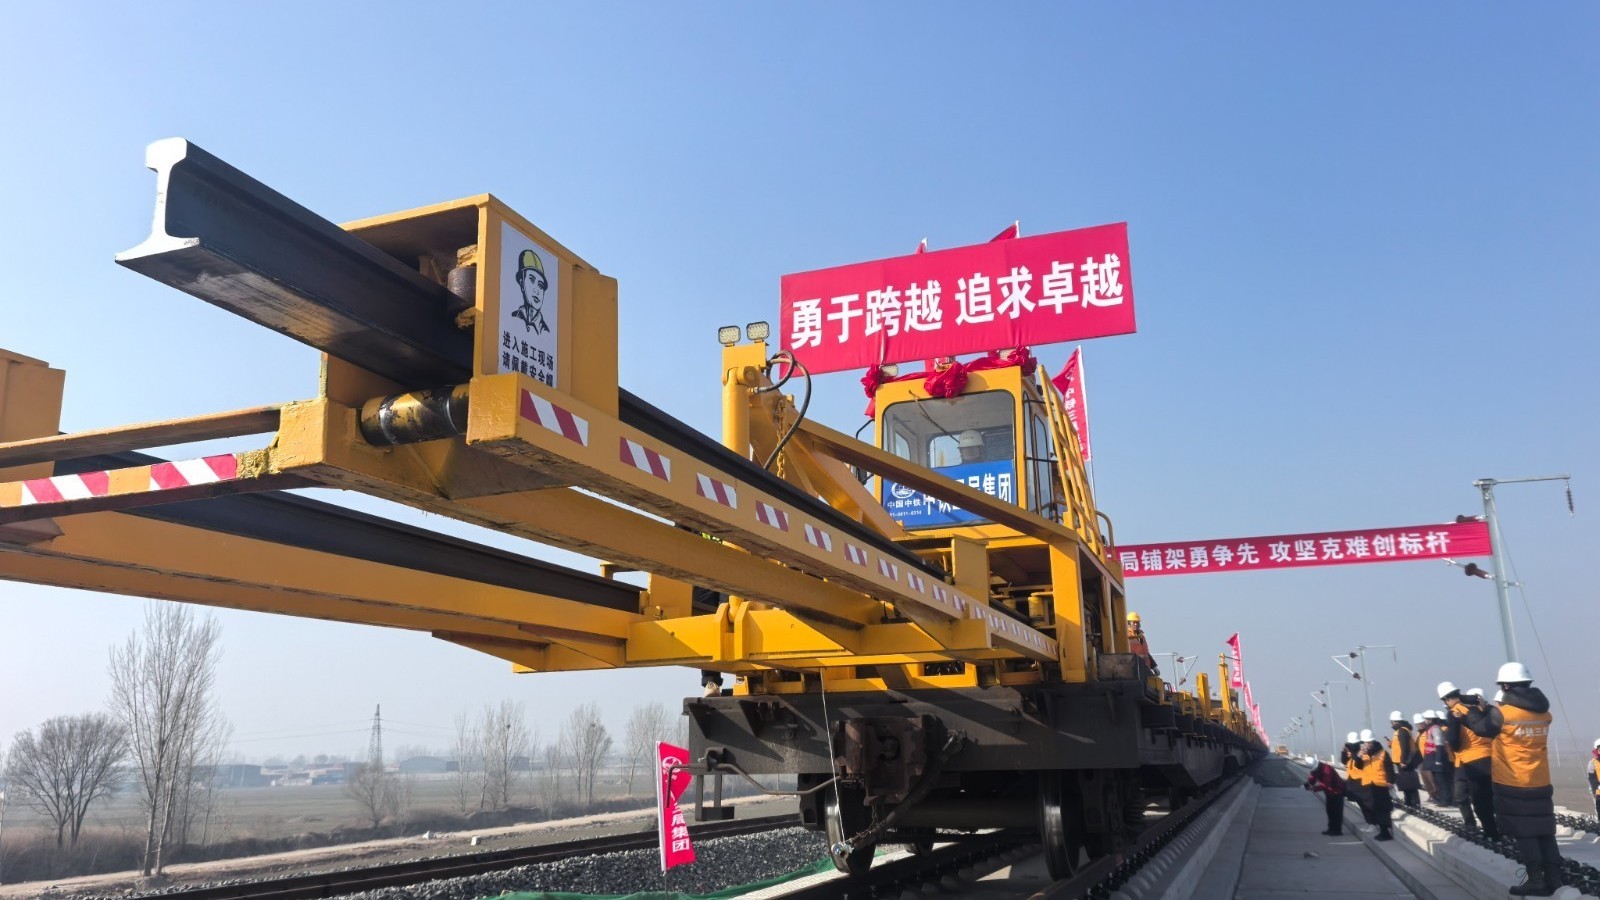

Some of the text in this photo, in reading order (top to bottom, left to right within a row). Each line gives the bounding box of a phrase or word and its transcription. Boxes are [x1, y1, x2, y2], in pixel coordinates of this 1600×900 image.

[791, 253, 1124, 349] 勇于跨越 追求卓越
[502, 330, 554, 371] 进入施工现场
[887, 498, 921, 509] 中国中铁
[1107, 530, 1451, 573] 局铺架勇争先 攻坚克难创标杆
